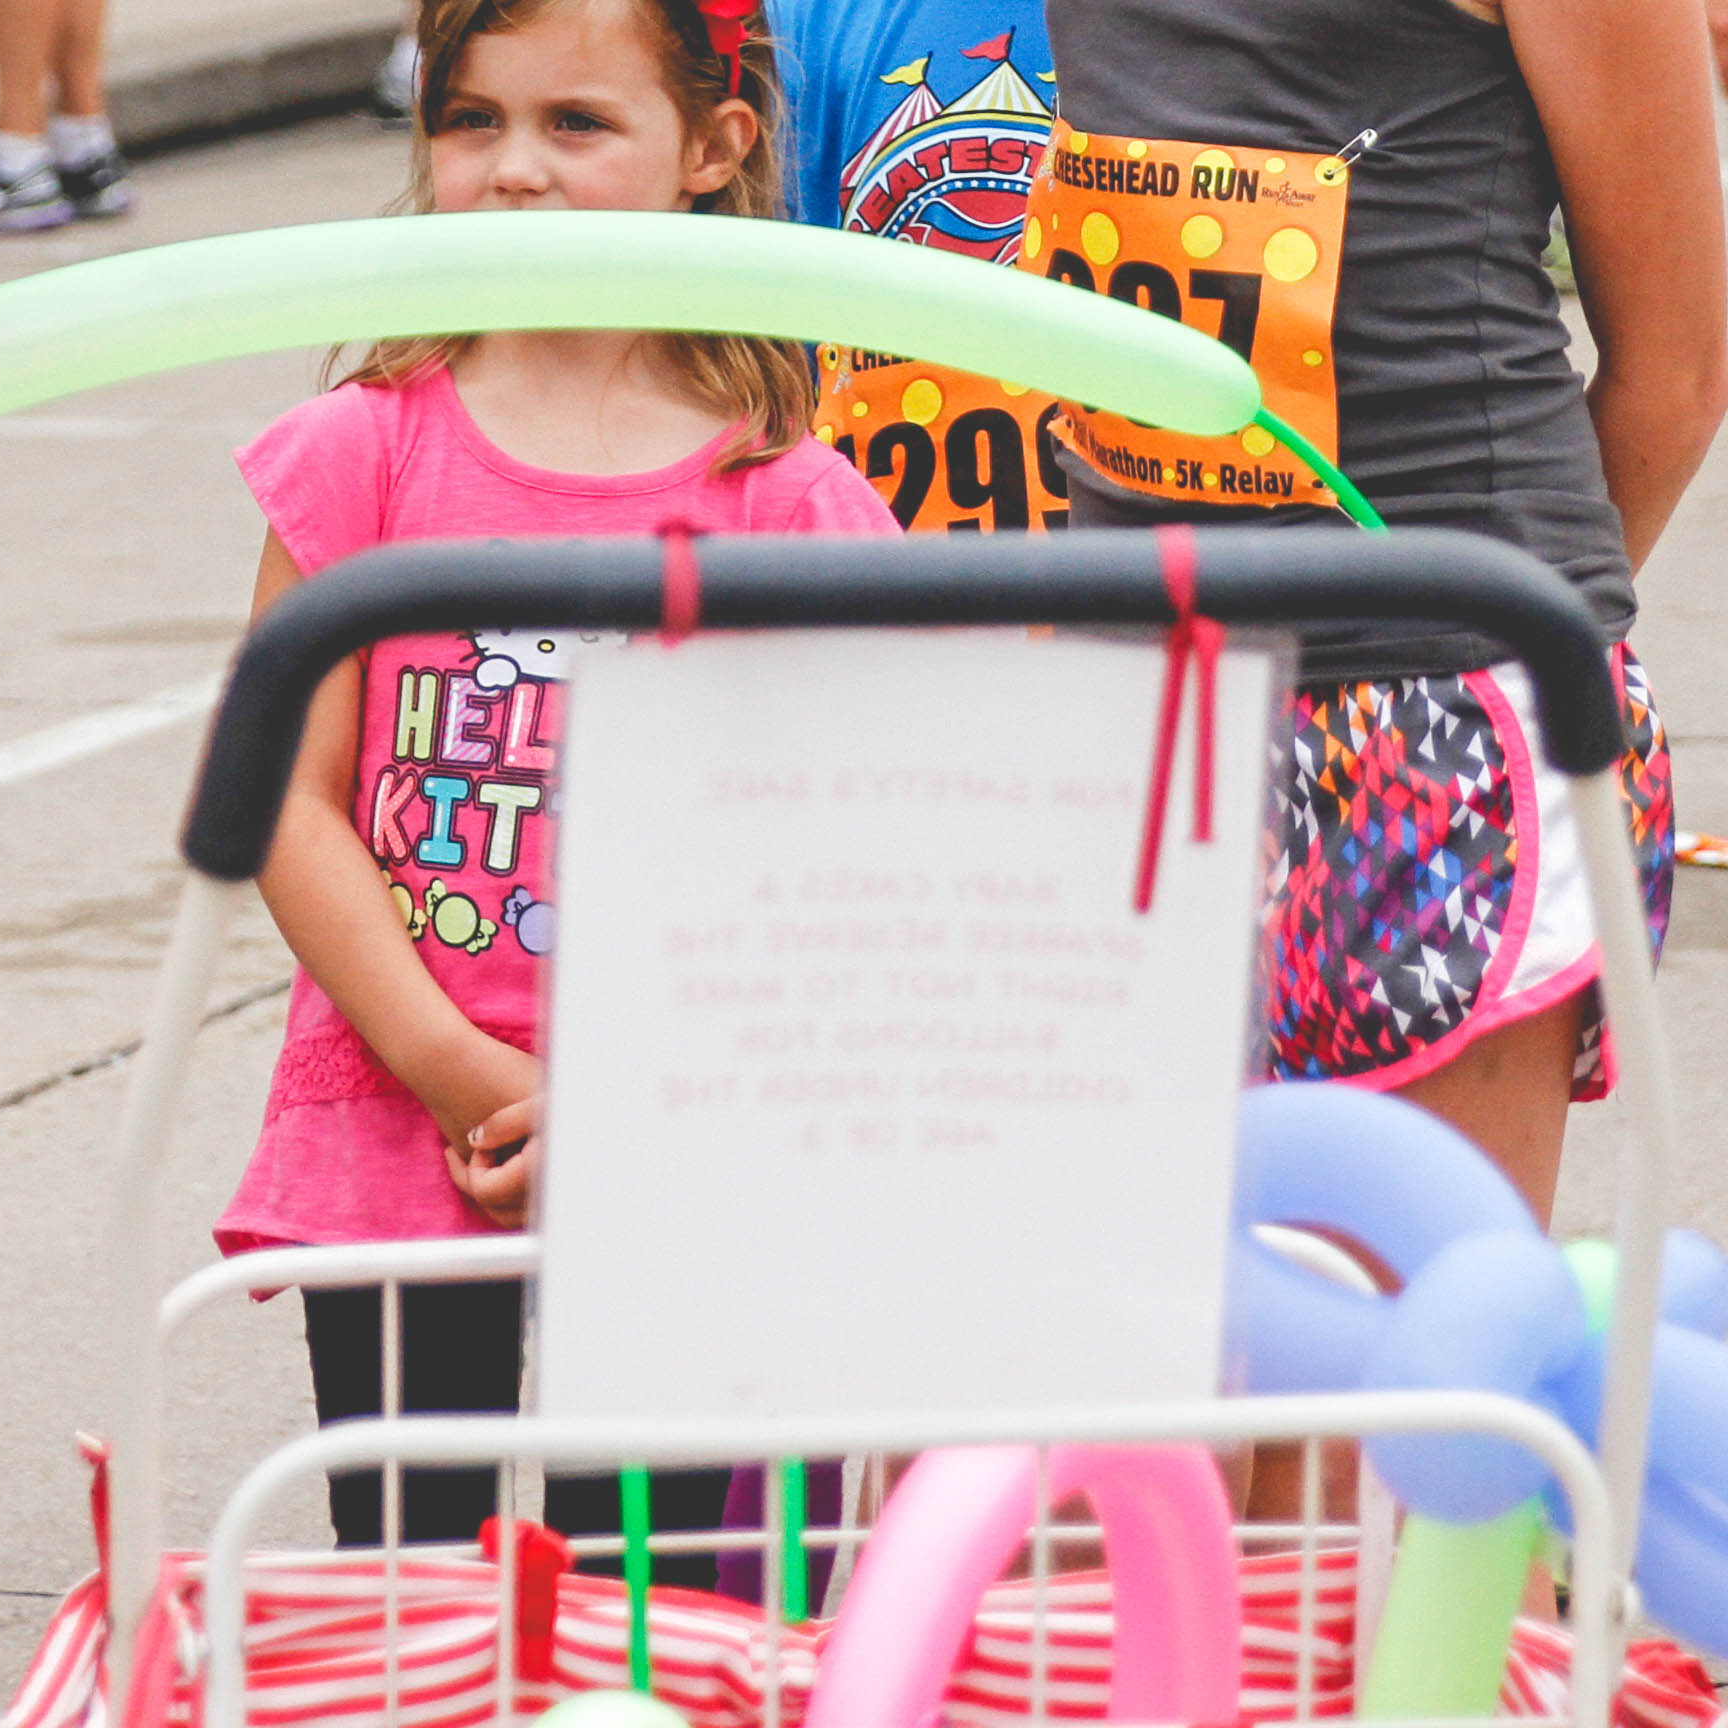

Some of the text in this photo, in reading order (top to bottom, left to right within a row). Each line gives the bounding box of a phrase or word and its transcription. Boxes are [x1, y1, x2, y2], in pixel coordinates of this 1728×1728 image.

[1054, 149, 1260, 204] CHEESEHEAD RUN
[1176, 458, 1204, 490] 5K
[1219, 463, 1295, 498] Relay
[392, 664, 560, 774] HEL
[370, 766, 562, 877] KIT
